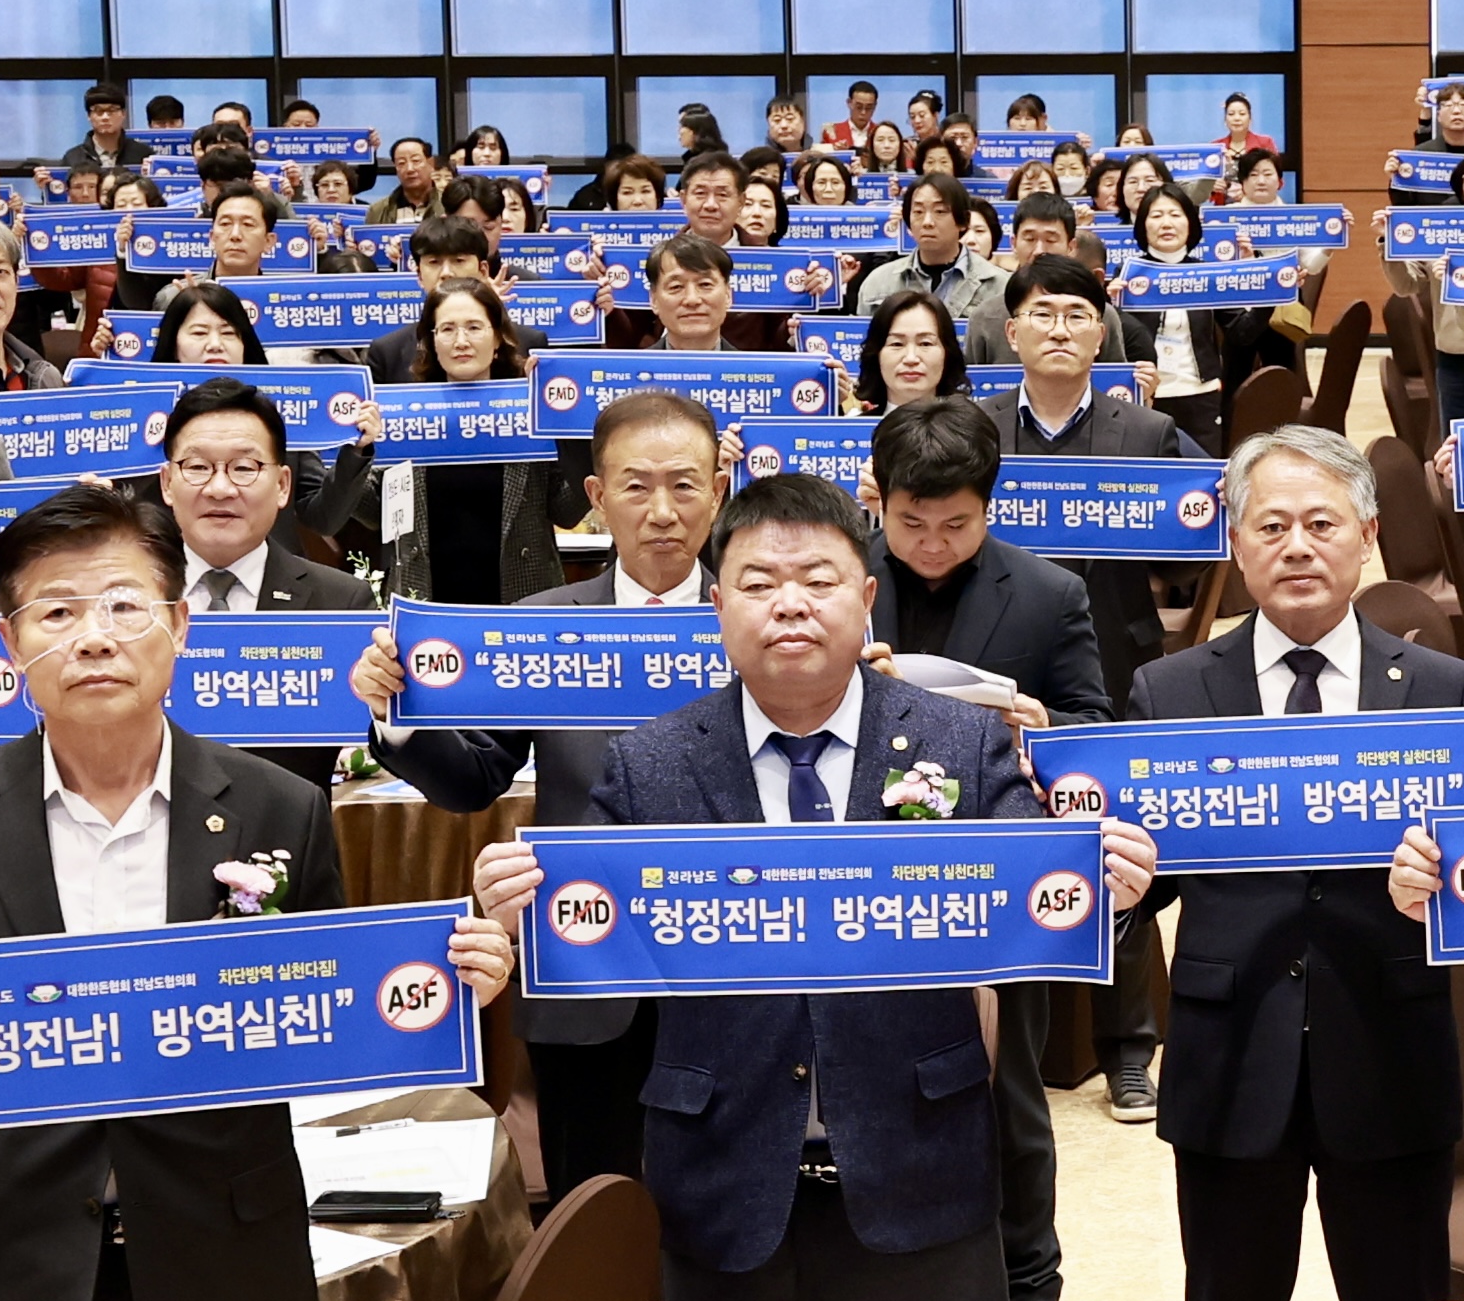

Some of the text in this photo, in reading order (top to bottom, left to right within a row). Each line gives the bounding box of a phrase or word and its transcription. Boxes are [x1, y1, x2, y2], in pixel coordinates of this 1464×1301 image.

[1152, 270, 1273, 295] “청정전남! 방역실천!”
[263, 305, 342, 328] “청정전남!
[1062, 499, 1167, 530] 방역실천!”
[415, 653, 459, 674] FMD
[475, 651, 622, 689] “청정전남!
[1152, 760, 1199, 775] 전라남도
[1050, 790, 1102, 819] FMD
[1118, 774, 1464, 831] “청정전남! 방역실천!”
[666, 870, 718, 885] 전라남도
[761, 867, 873, 882] 대한한돈협회 전남도협의회
[891, 863, 995, 881] 차단방역 실천다짐!
[557, 899, 610, 925] FMD
[1036, 887, 1081, 913] ASF
[630, 889, 1008, 945] “청정전남! 방역실천!”
[66, 973, 197, 998] 대한한돈협회 전남도협의회
[218, 959, 337, 986] 차단방역 실천다짐!
[388, 981, 437, 1013] ASF
[152, 988, 354, 1058] 방역실천!”
